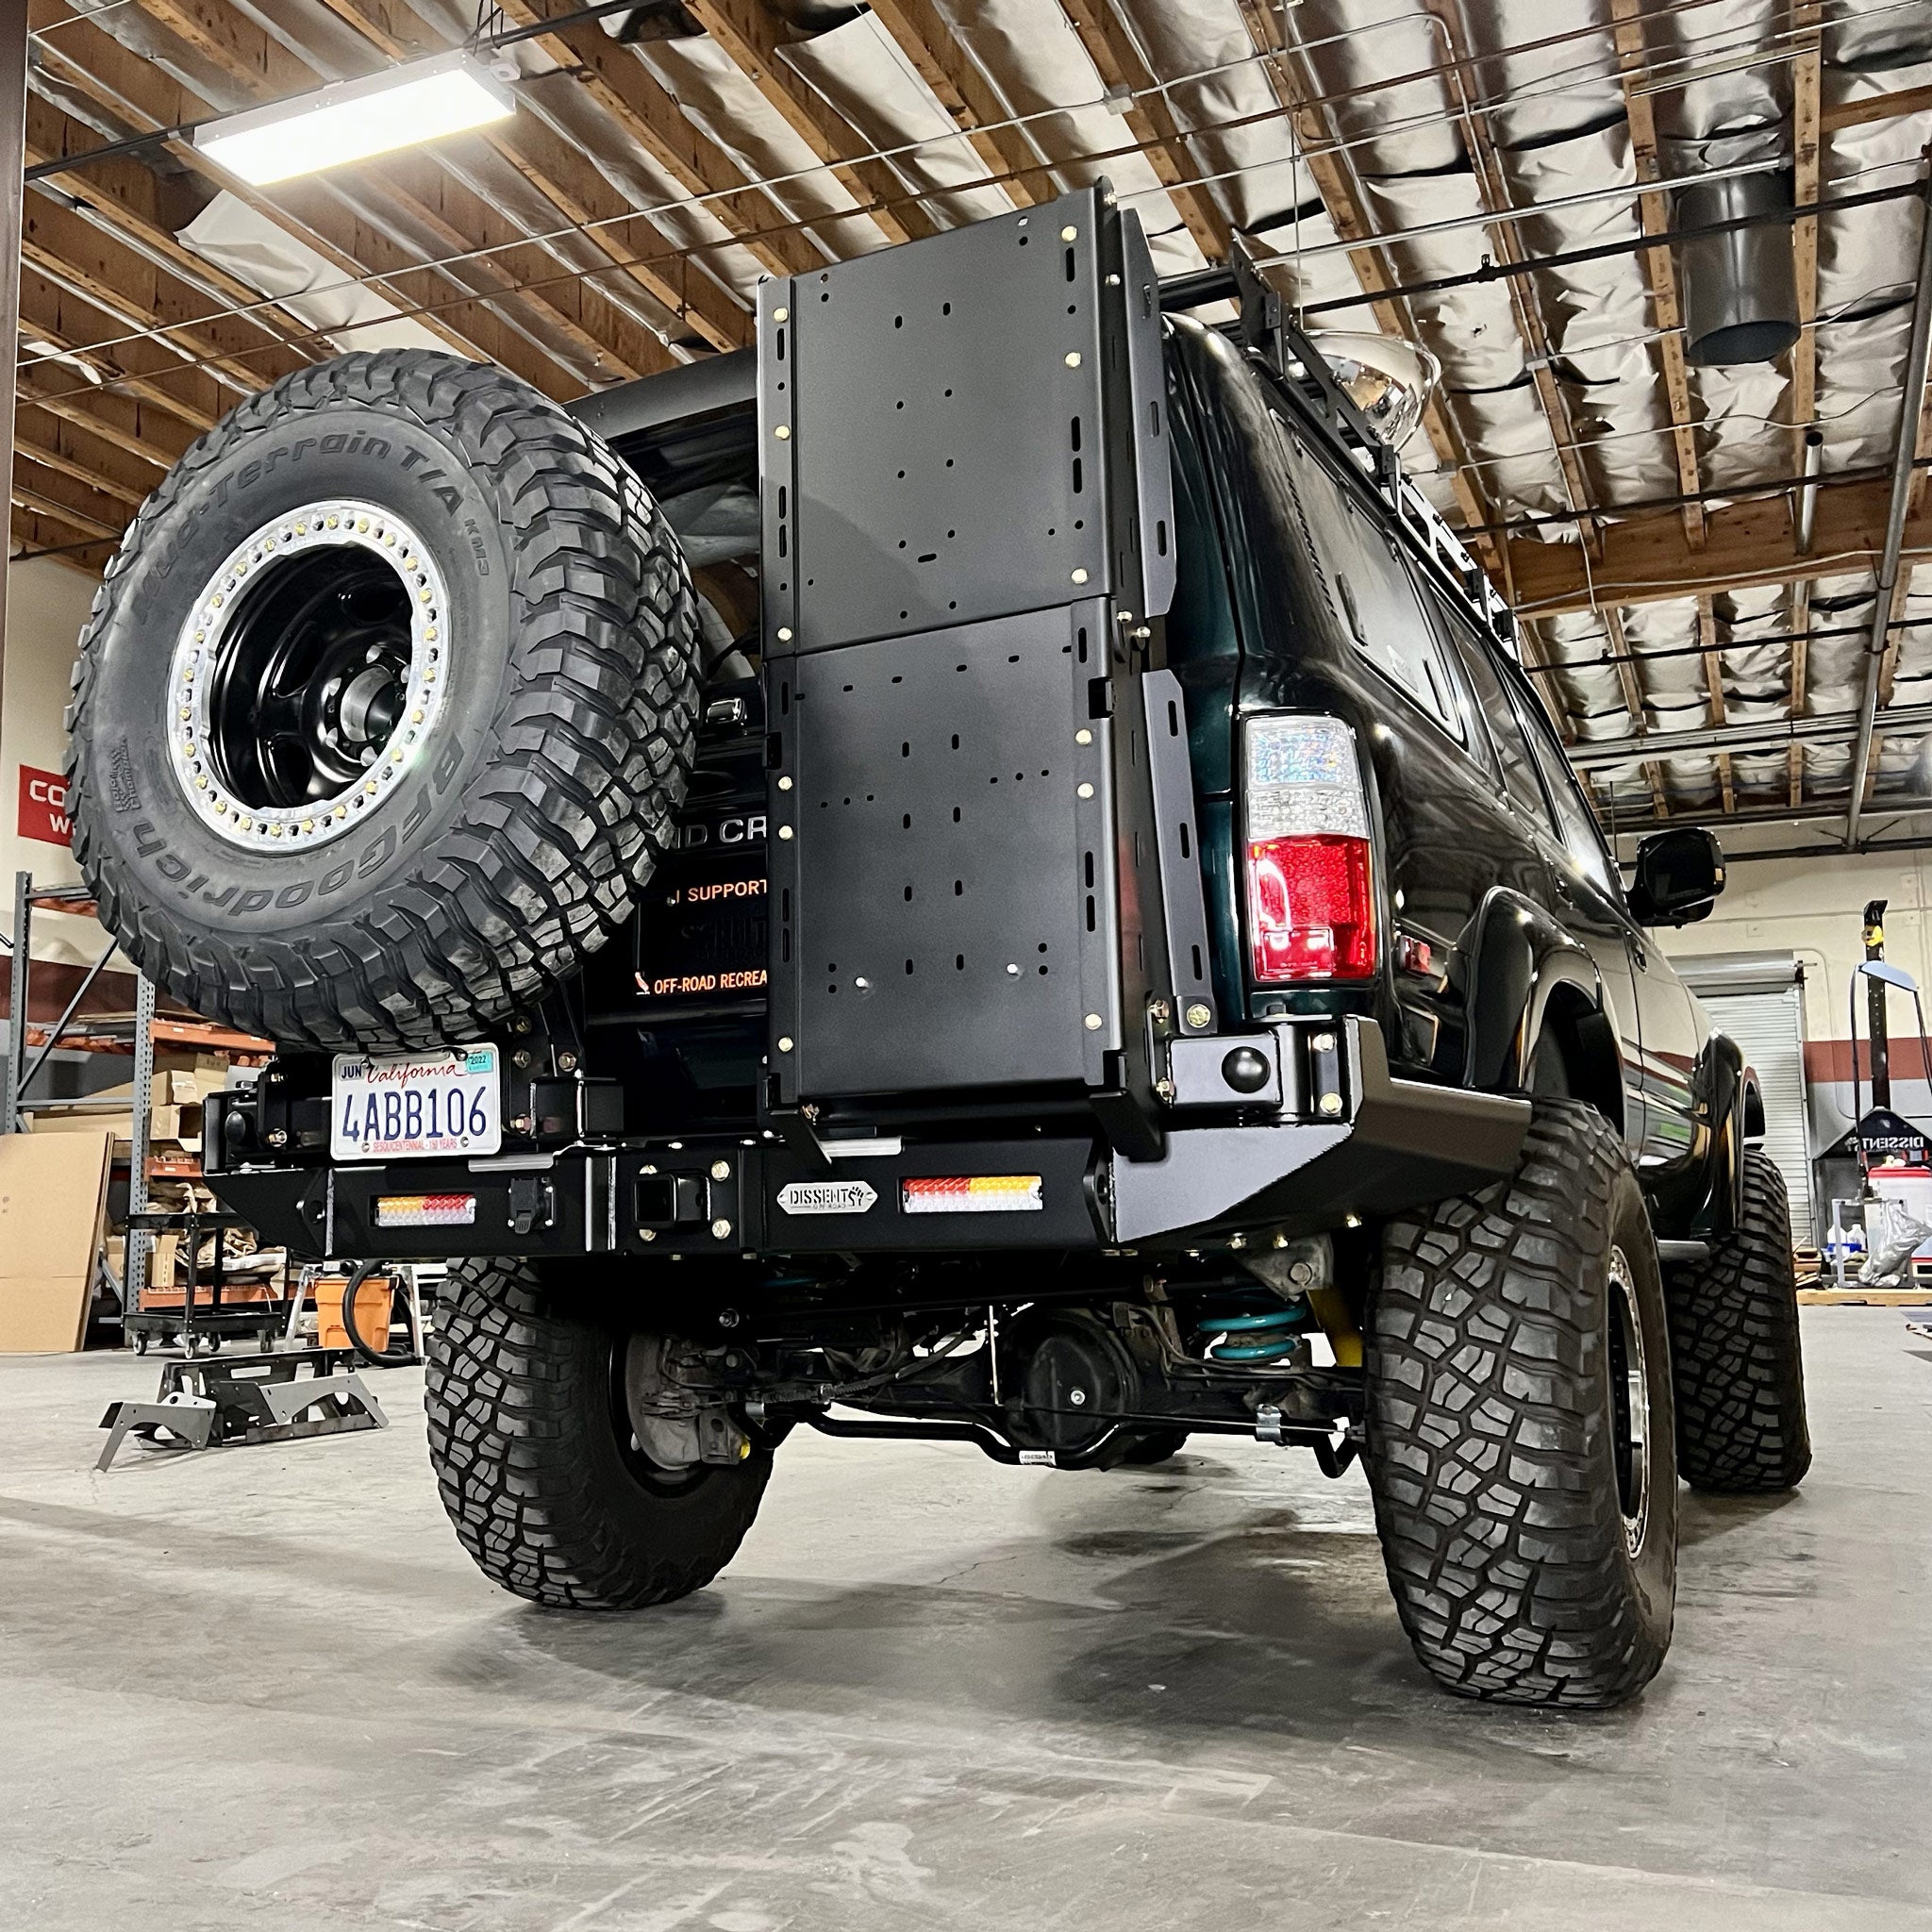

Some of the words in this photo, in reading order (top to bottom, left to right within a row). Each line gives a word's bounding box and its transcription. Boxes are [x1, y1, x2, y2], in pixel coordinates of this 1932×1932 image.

[29, 779, 71, 807] CO
[133, 734, 465, 916] BFGoodrich
[655, 974, 716, 994] OFF-ROAD
[341, 1065, 362, 1079] JUN
[367, 1062, 468, 1089] California
[342, 1086, 487, 1141] 4ABB106
[791, 1189, 848, 1205] DISSENT
